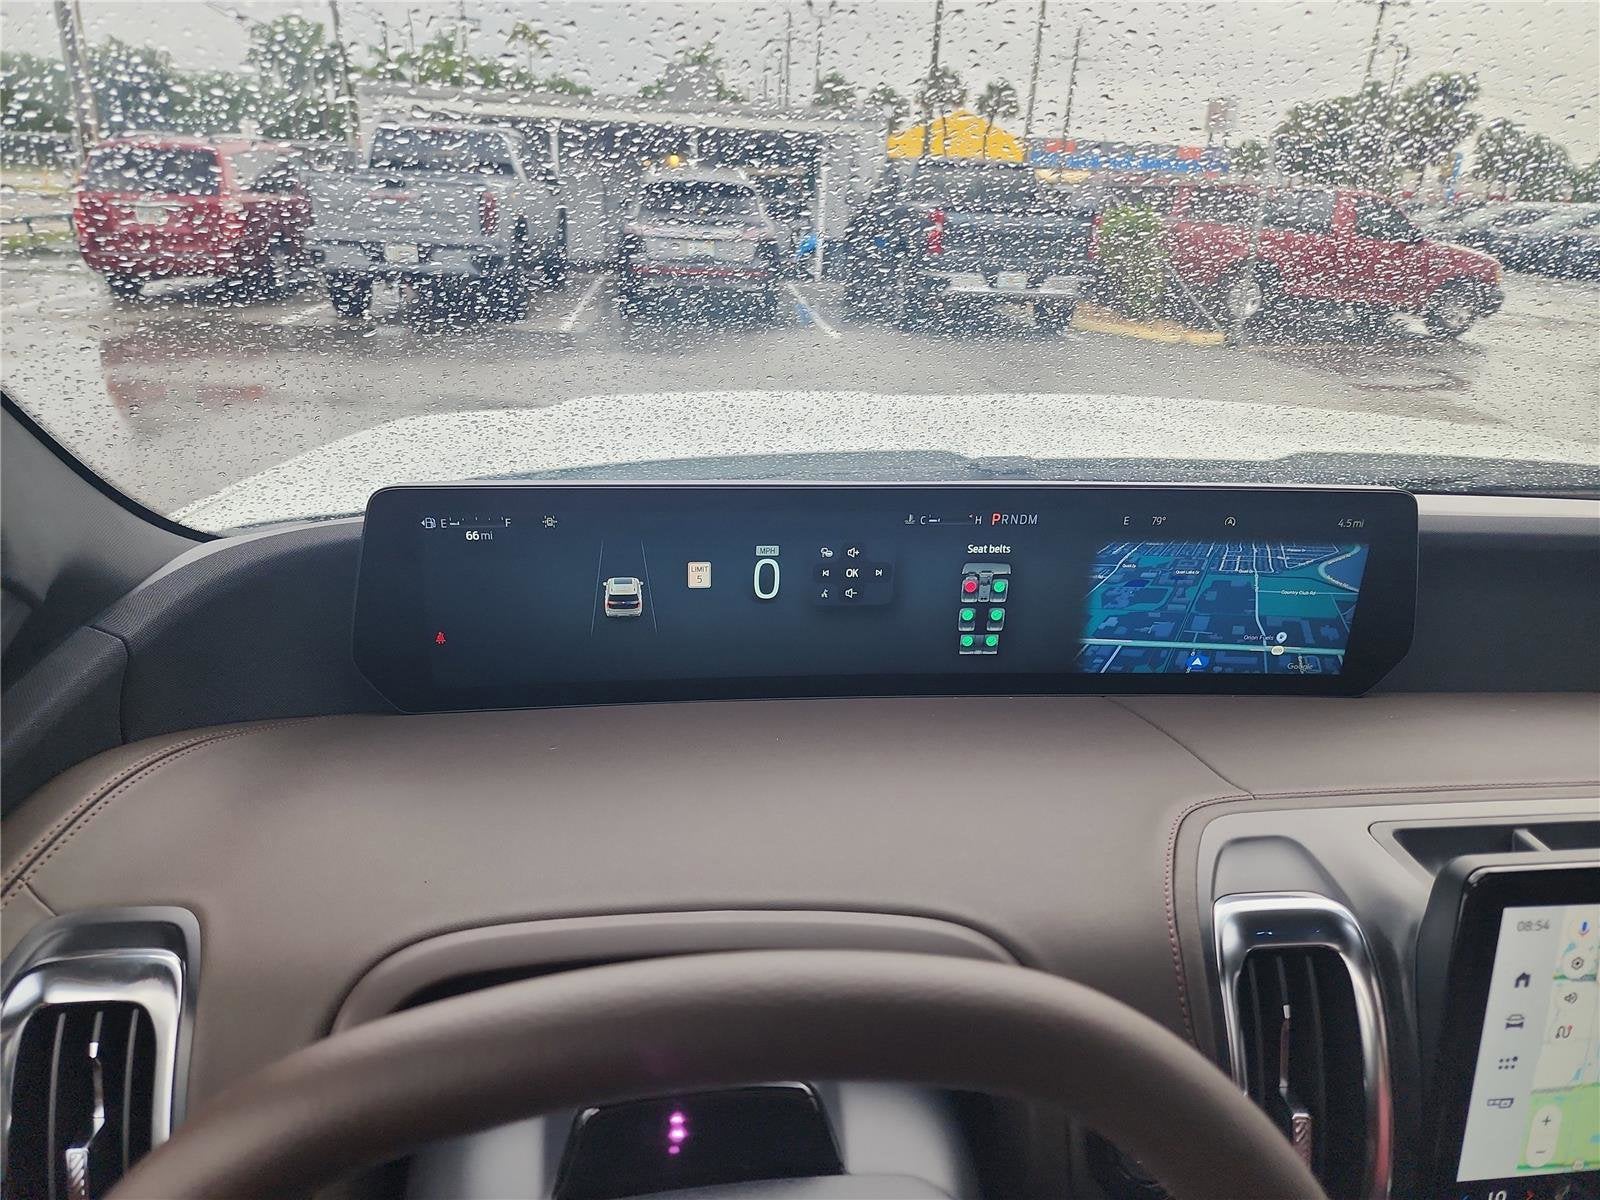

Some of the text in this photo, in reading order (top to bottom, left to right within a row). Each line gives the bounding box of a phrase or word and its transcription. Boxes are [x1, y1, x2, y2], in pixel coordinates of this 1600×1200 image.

[440, 518, 447, 528] E
[505, 518, 512, 528] F
[920, 515, 926, 525] C
[974, 515, 982, 525] H
[1123, 516, 1130, 526] E
[759, 547, 776, 555] MPH
[967, 544, 1011, 554] Seat belts
[690, 565, 709, 573] LIMIT
[845, 568, 859, 578] OK
[696, 575, 703, 584] 5
[753, 558, 781, 600] 0
[1287, 662, 1313, 672] Google
